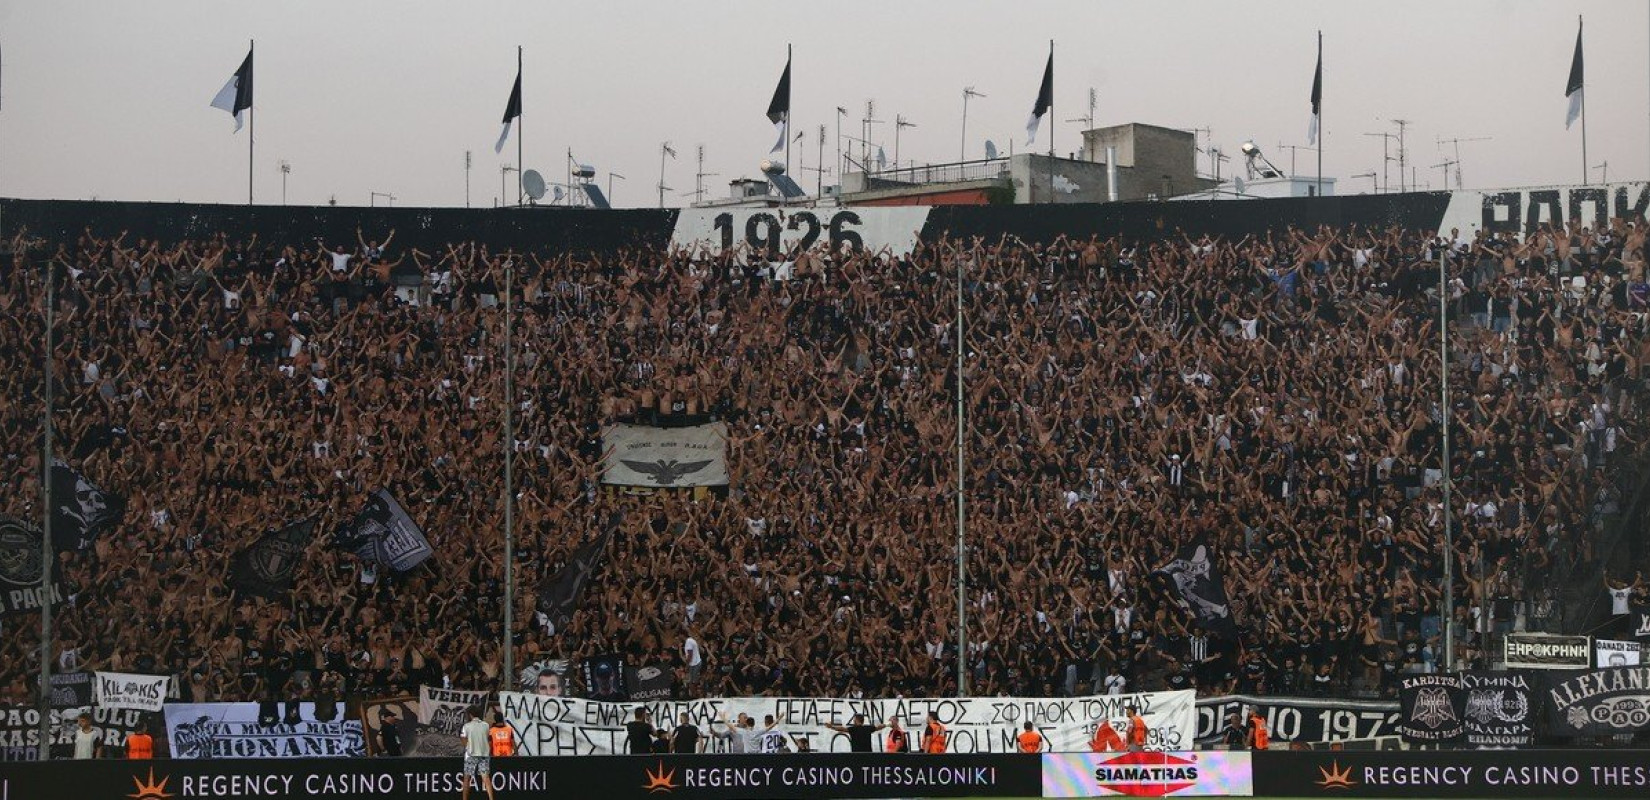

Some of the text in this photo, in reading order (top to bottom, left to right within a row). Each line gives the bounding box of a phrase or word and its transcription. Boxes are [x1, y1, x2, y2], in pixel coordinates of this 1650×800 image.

[714, 210, 864, 258] 1926
[420, 689, 484, 709] VERIA
[504, 695, 575, 724] ΑΛΛΟΣ
[585, 701, 633, 726] ΕΝΑΣ
[846, 699, 885, 726] ΣΑΝ
[990, 703, 1021, 725] ΣΦ
[1025, 701, 1076, 723] ΠΑΟΚ
[1079, 693, 1156, 721] ΤΟΥΜΠΑΣ
[306, 722, 341, 735] ΜΑΣ
[212, 736, 345, 757] ΠΟΝΑΝΕ
[768, 734, 781, 750] 20
[685, 767, 996, 787] REGENCY CASINO THESSALONIKI
[1095, 767, 1197, 781] SIAMATRAS
[1364, 767, 1471, 785] REGENCY
[1485, 767, 1578, 785] CASINO
[183, 775, 294, 796] REGENCY
[305, 774, 394, 794] CASINO
